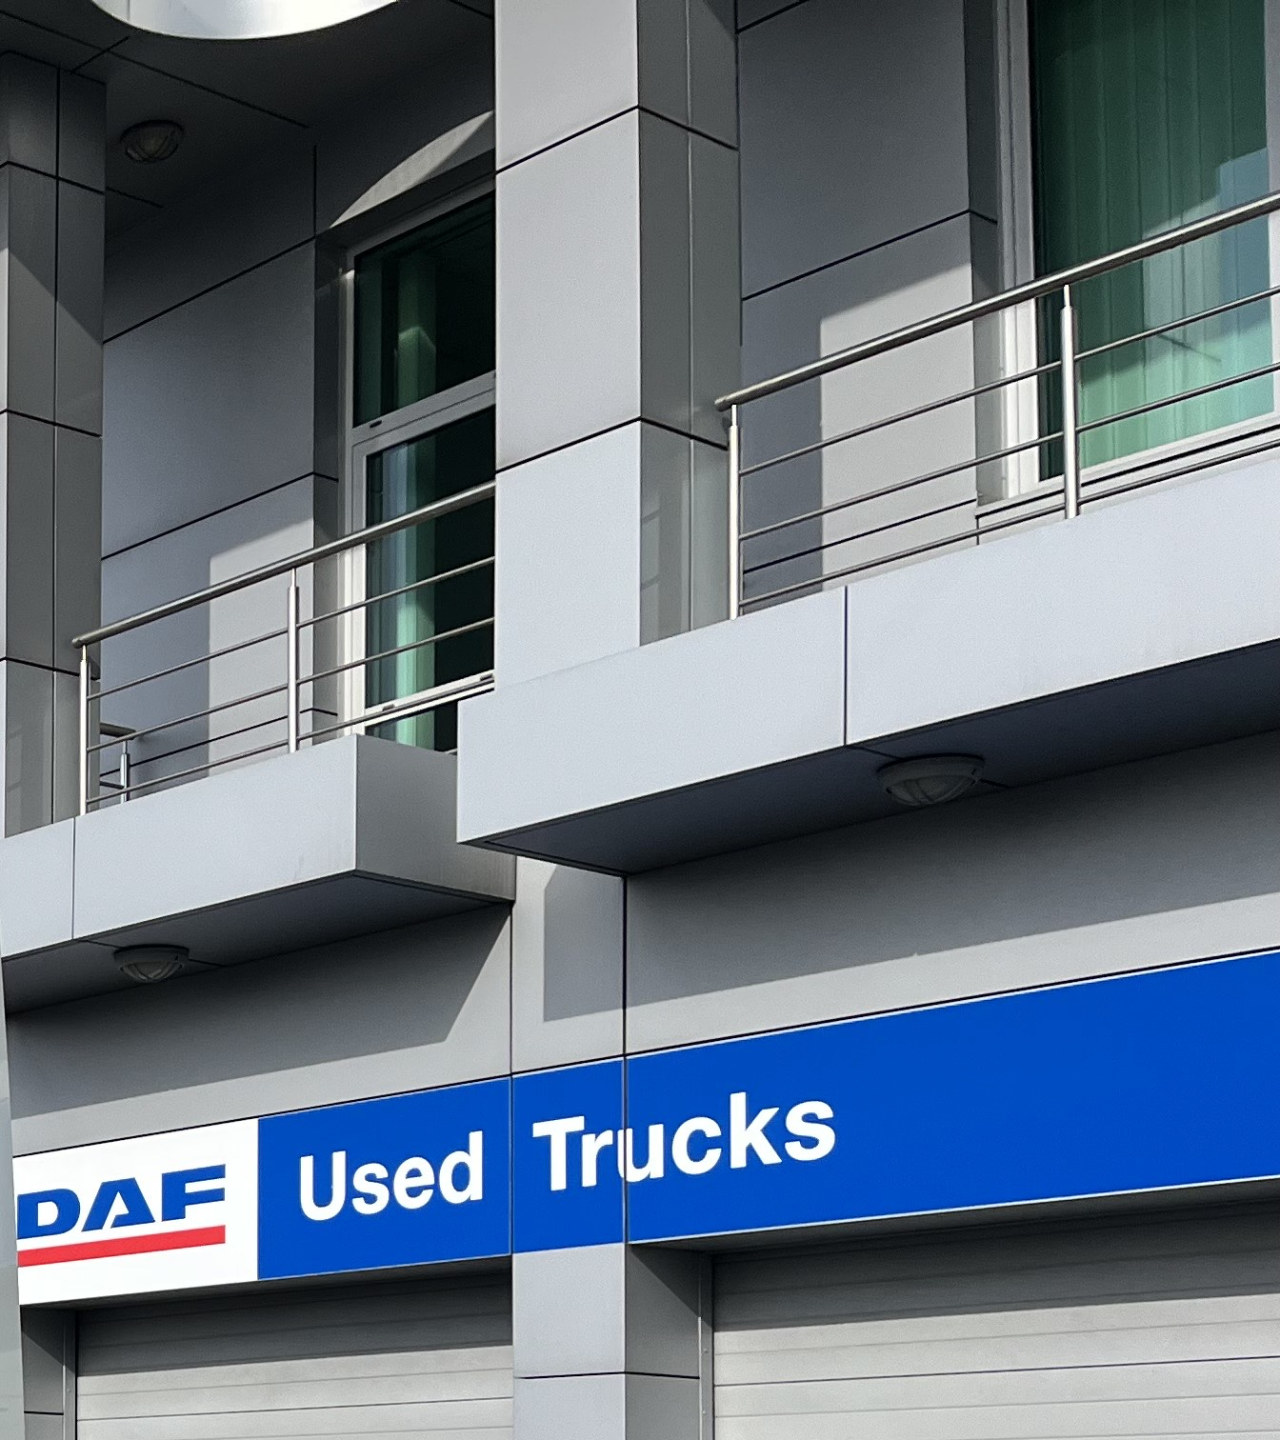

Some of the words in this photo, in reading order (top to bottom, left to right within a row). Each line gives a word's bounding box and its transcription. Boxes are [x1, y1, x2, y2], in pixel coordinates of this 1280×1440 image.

[17, 1164, 226, 1240] DAF
[299, 1130, 483, 1222] Used
[532, 1092, 837, 1192] Trucks
